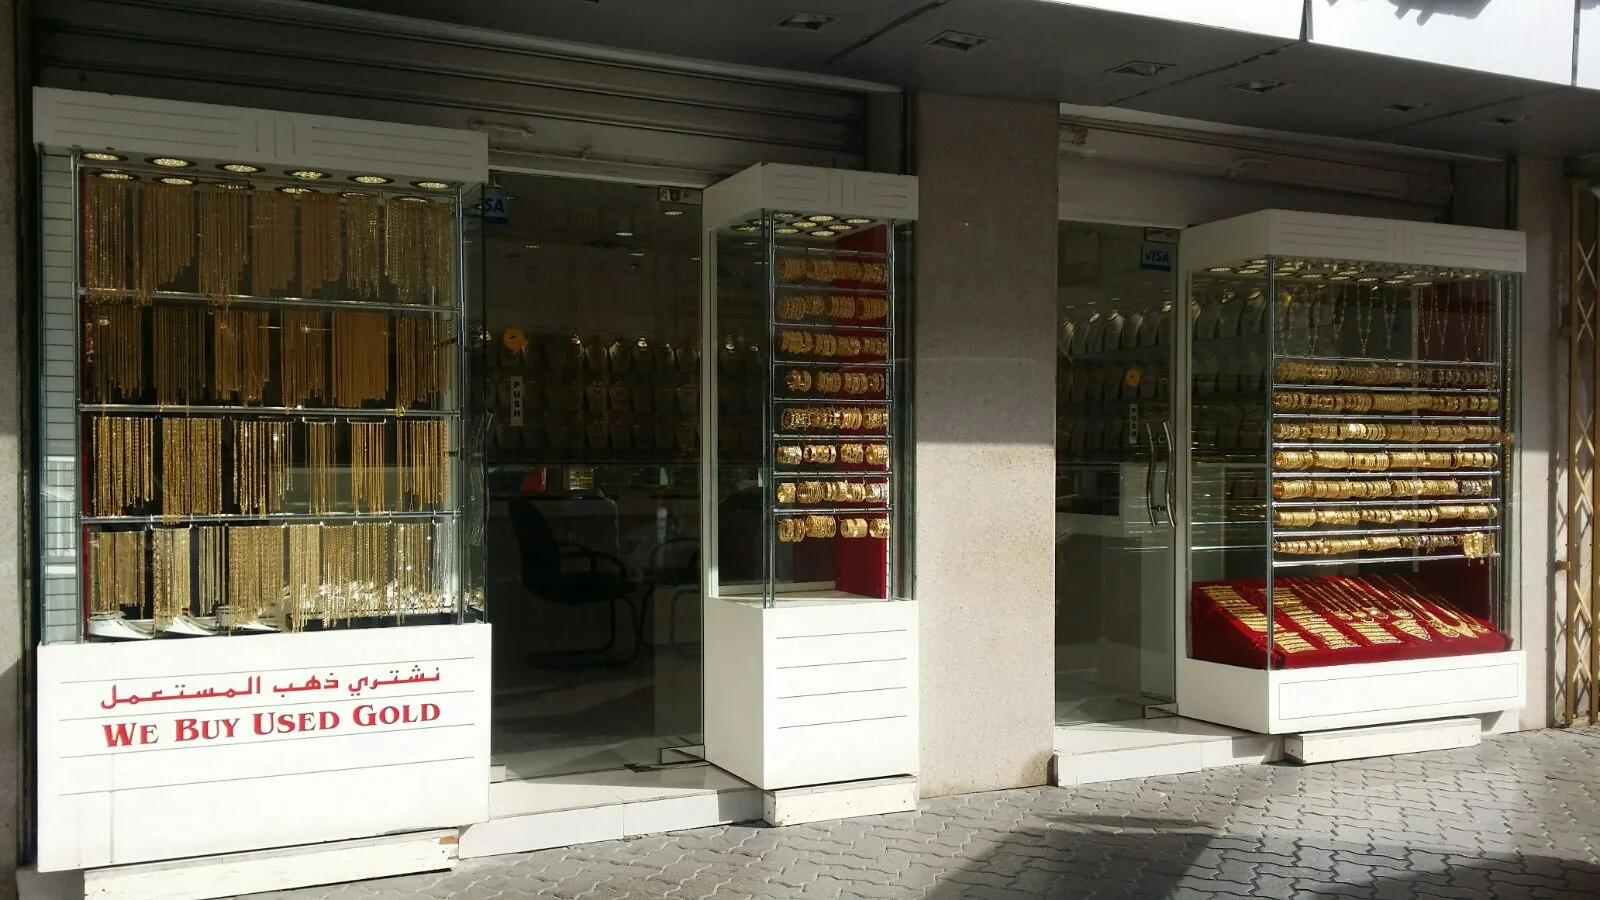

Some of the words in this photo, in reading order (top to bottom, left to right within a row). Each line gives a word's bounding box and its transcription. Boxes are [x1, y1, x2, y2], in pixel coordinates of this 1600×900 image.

[1145, 250, 1169, 264] VISA
[100, 675, 261, 710] المستعمل
[272, 672, 338, 698] ذهب
[348, 664, 440, 697] نشتري
